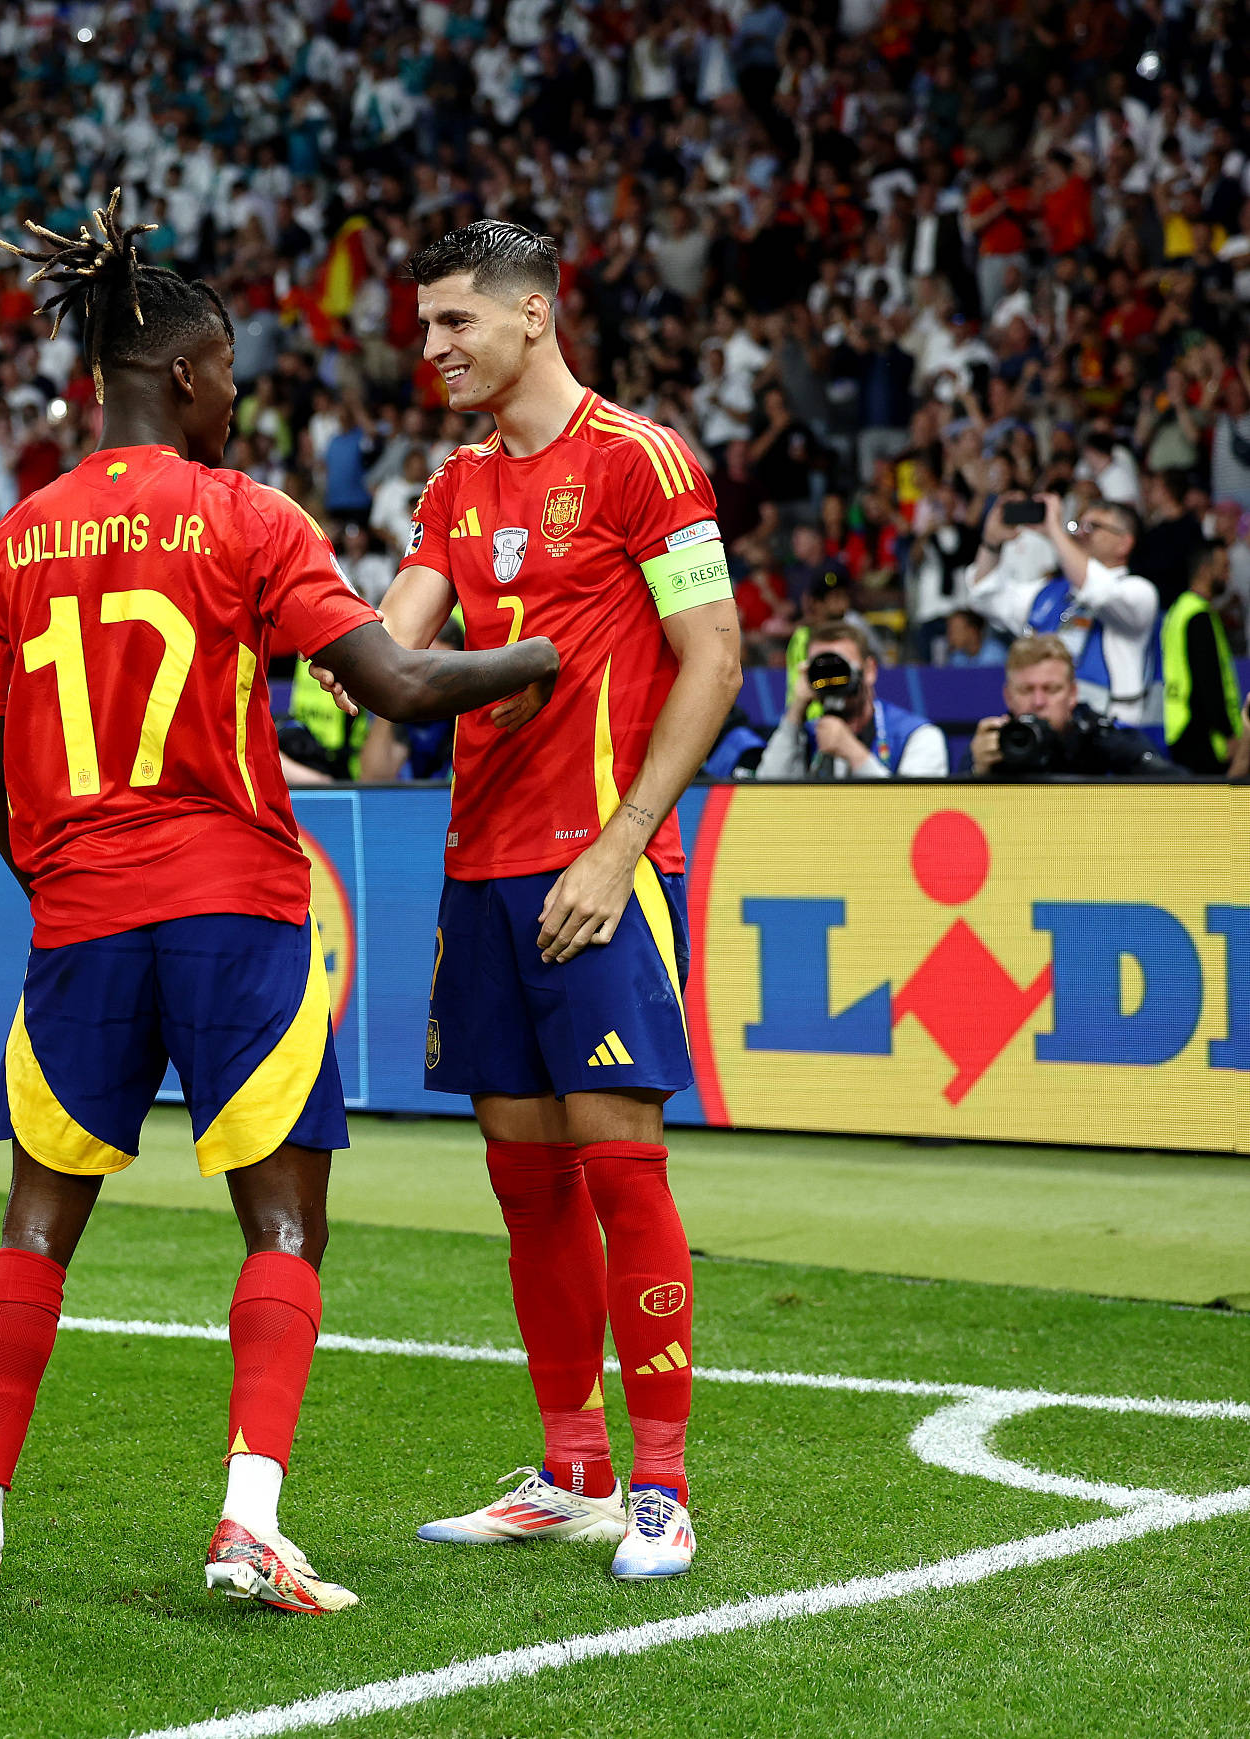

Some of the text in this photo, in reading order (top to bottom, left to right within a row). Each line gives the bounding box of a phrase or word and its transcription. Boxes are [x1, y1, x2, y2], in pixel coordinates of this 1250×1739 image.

[7, 513, 211, 570] WILLIAMS JR.
[496, 595, 525, 647] 7
[23, 589, 197, 797] 17
[555, 829, 588, 839] HEAT.RDY
